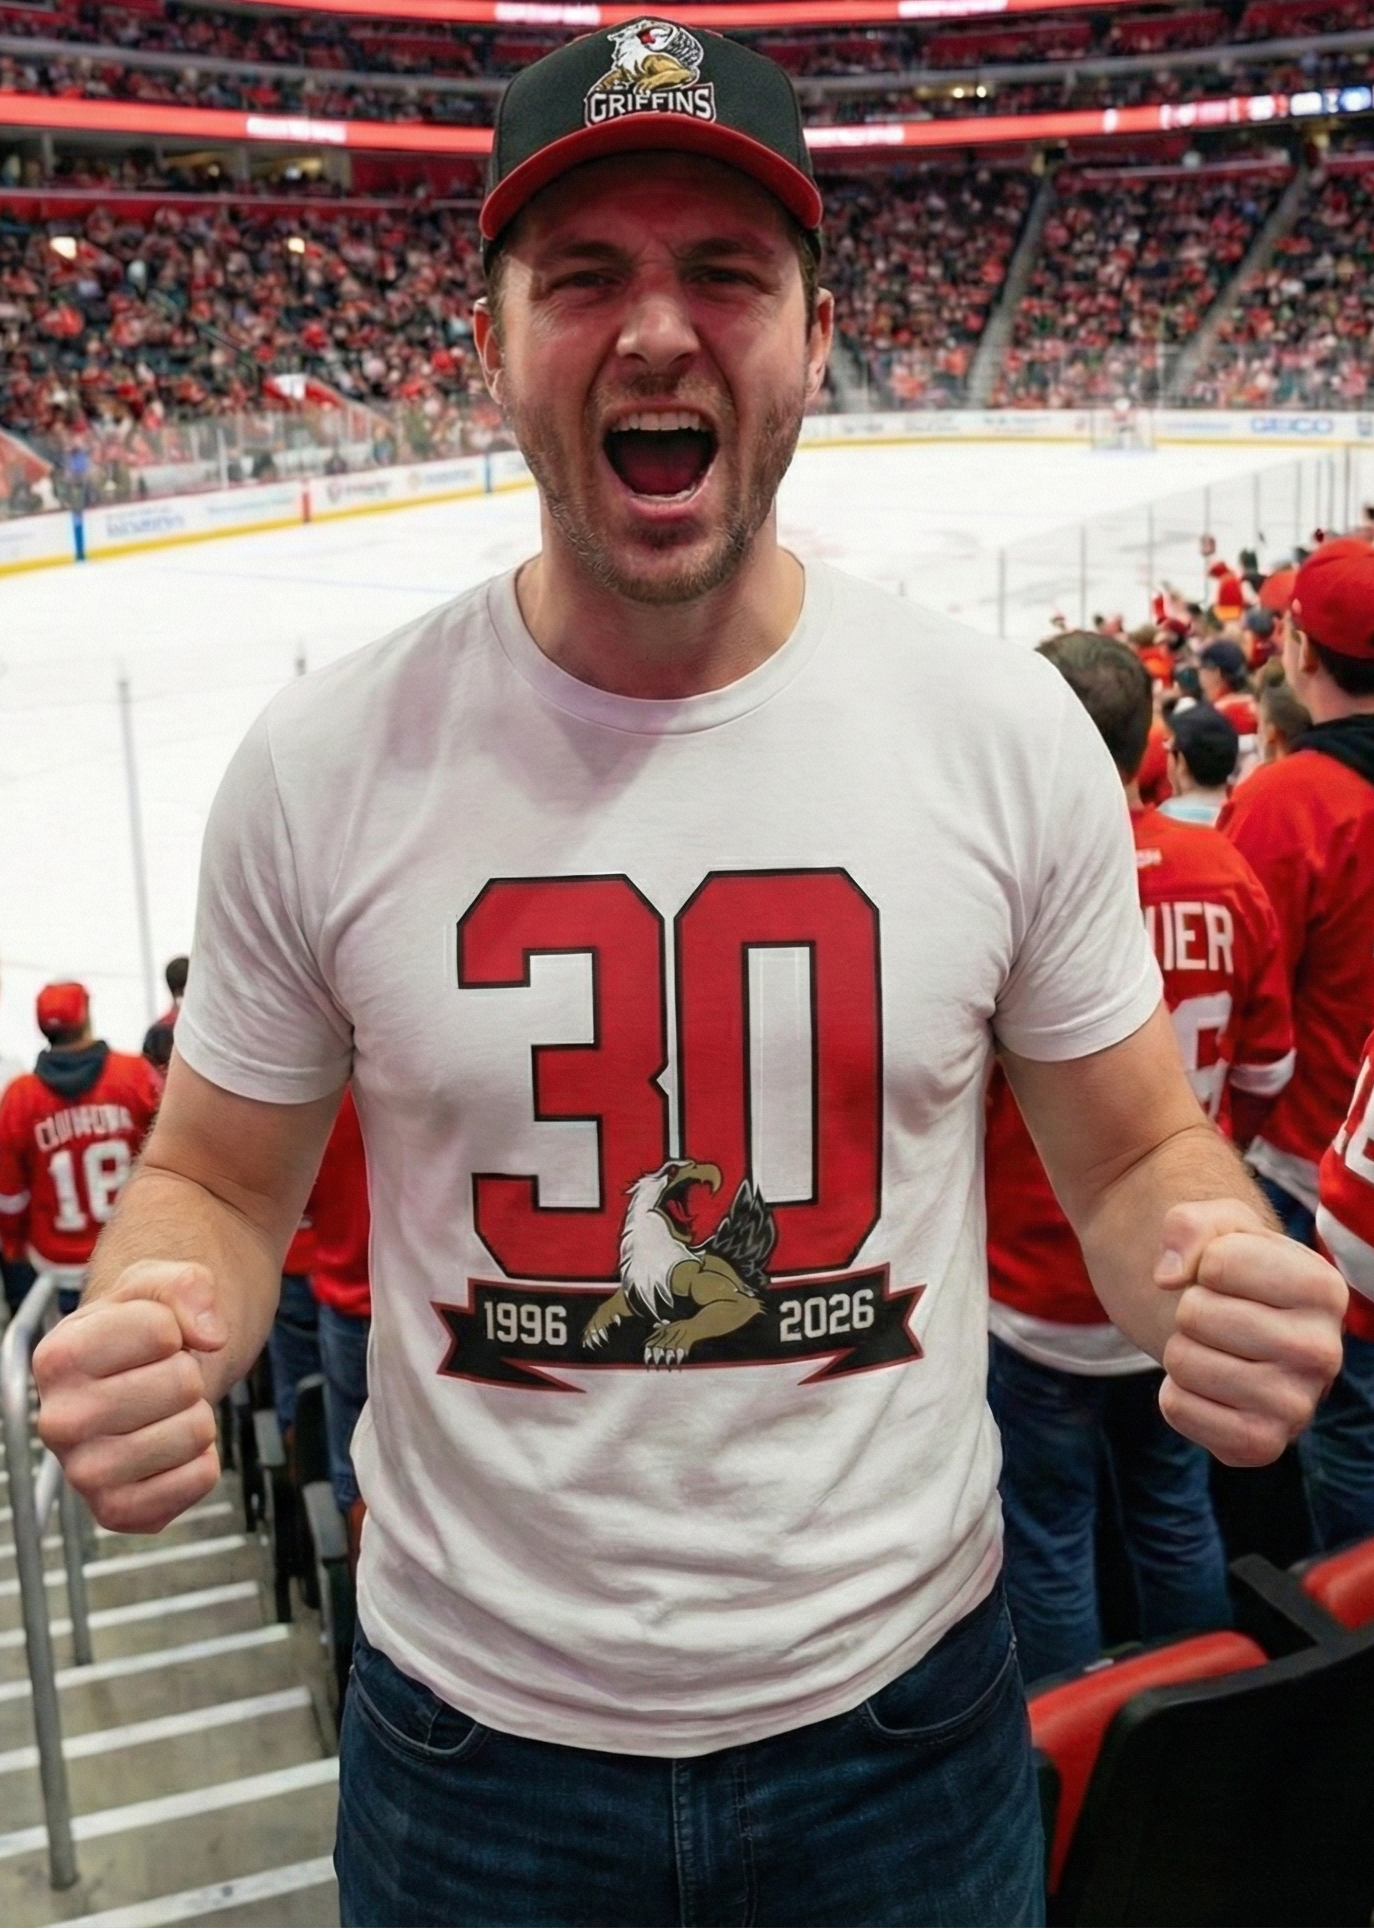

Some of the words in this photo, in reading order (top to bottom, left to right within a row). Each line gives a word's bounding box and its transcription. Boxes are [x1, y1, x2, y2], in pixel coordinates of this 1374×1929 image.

[590, 88, 712, 124] GRIFFINS
[456, 866, 882, 1280] 30
[47, 1138, 132, 1232] 18
[484, 1301, 568, 1346] 1996
[779, 1289, 875, 1343] 2026
